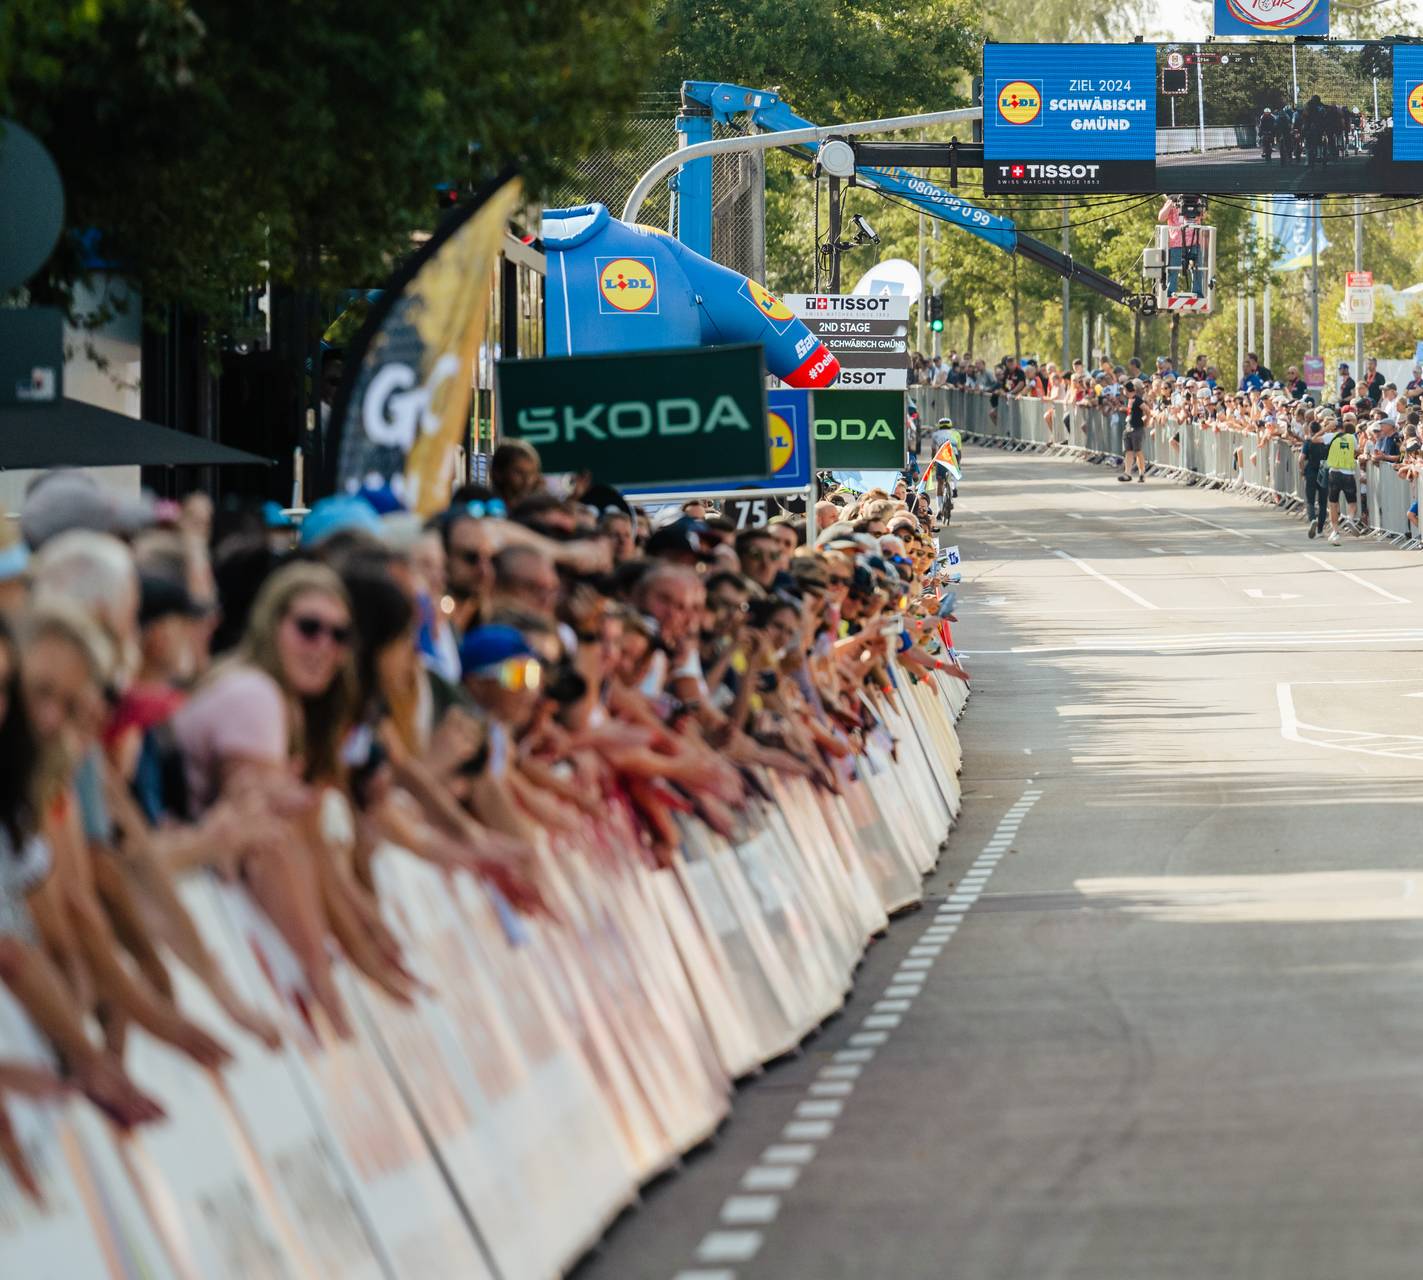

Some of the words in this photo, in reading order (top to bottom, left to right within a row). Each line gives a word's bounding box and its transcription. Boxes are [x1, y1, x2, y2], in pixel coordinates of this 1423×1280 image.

[1069, 79, 1095, 92] ZIEL
[1099, 79, 1132, 92] 2024
[1049, 96, 1147, 111] SCHWÄBISCH
[1071, 115, 1130, 131] GMÜND
[1026, 164, 1100, 178] TISSOT
[829, 297, 890, 310] TISSOT
[818, 322, 839, 333] 2ND
[840, 322, 871, 333] STAGE
[829, 338, 877, 348] SCHWÄBISCH
[878, 338, 906, 349] GMÜND
[814, 419, 896, 441] ODA
[735, 501, 768, 530] 75
